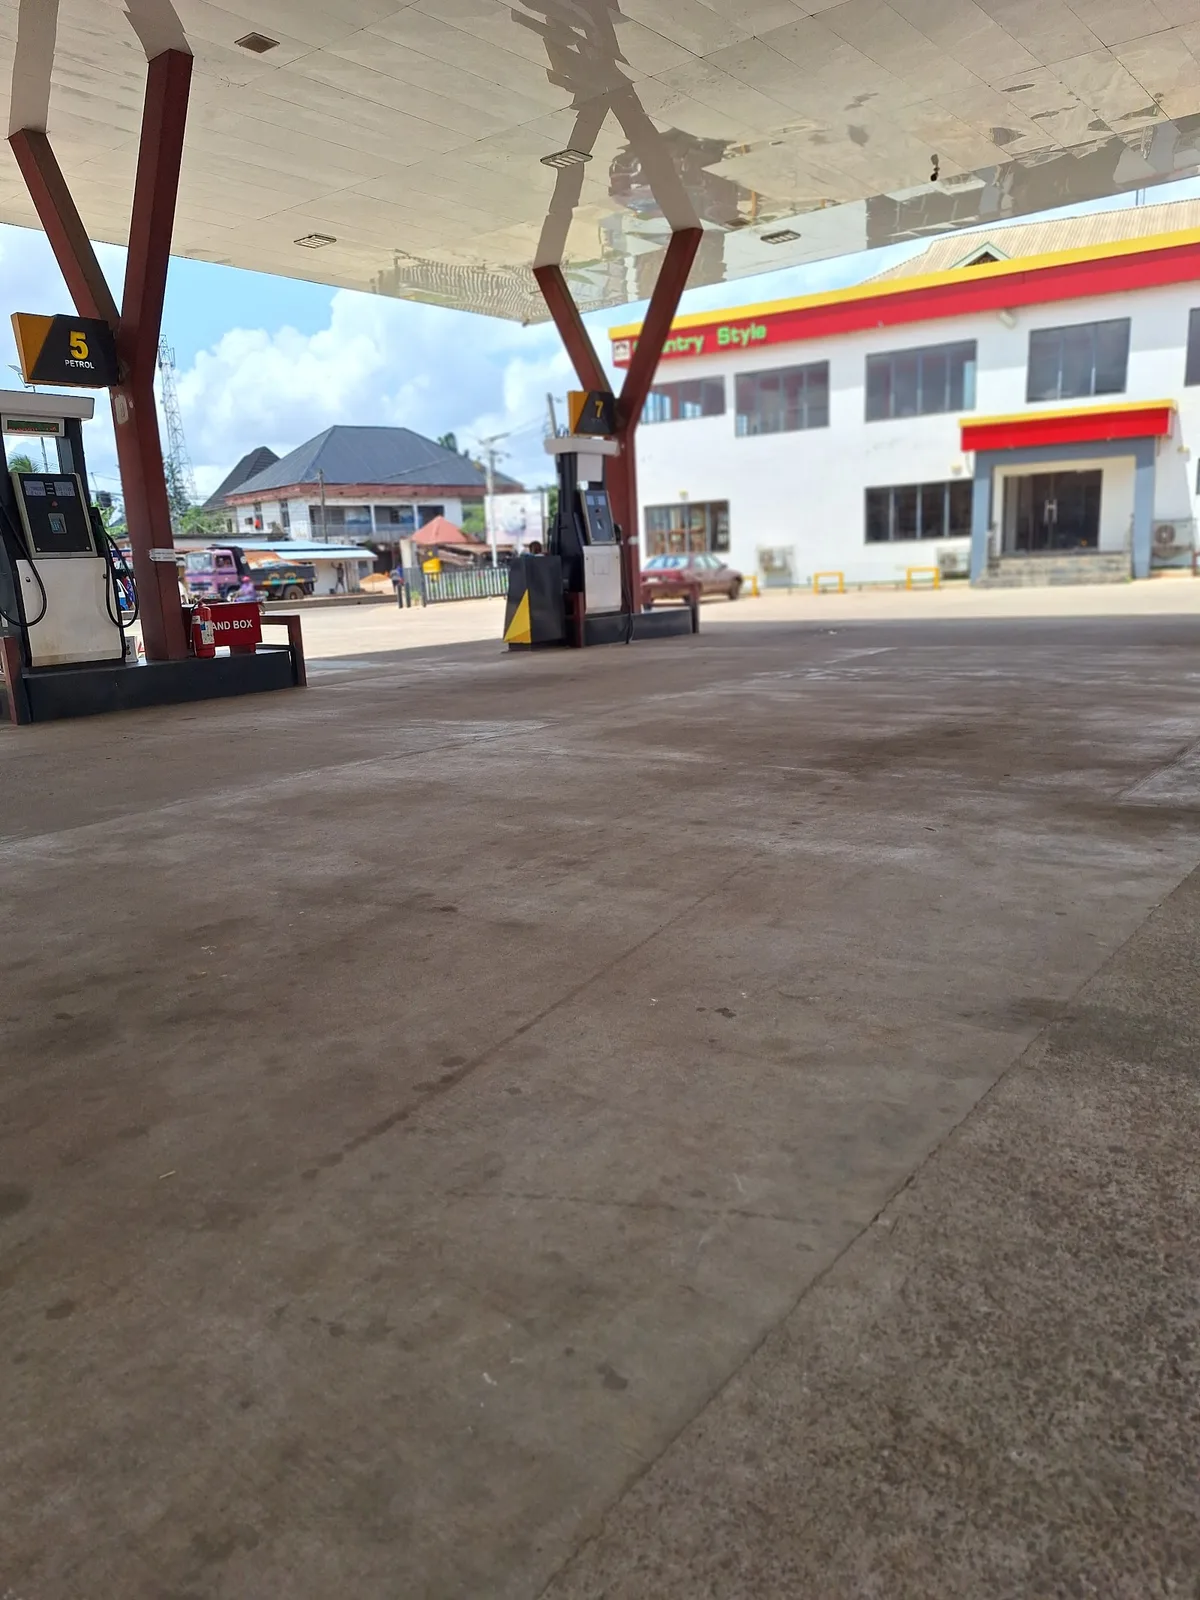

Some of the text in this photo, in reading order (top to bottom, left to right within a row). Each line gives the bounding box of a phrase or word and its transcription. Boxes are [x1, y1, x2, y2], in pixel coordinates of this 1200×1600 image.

[717, 322, 767, 346] Style
[69, 330, 89, 360] 5
[64, 359, 95, 369] PETROL
[595, 400, 604, 418] 7
[211, 619, 253, 631] AND BOX
